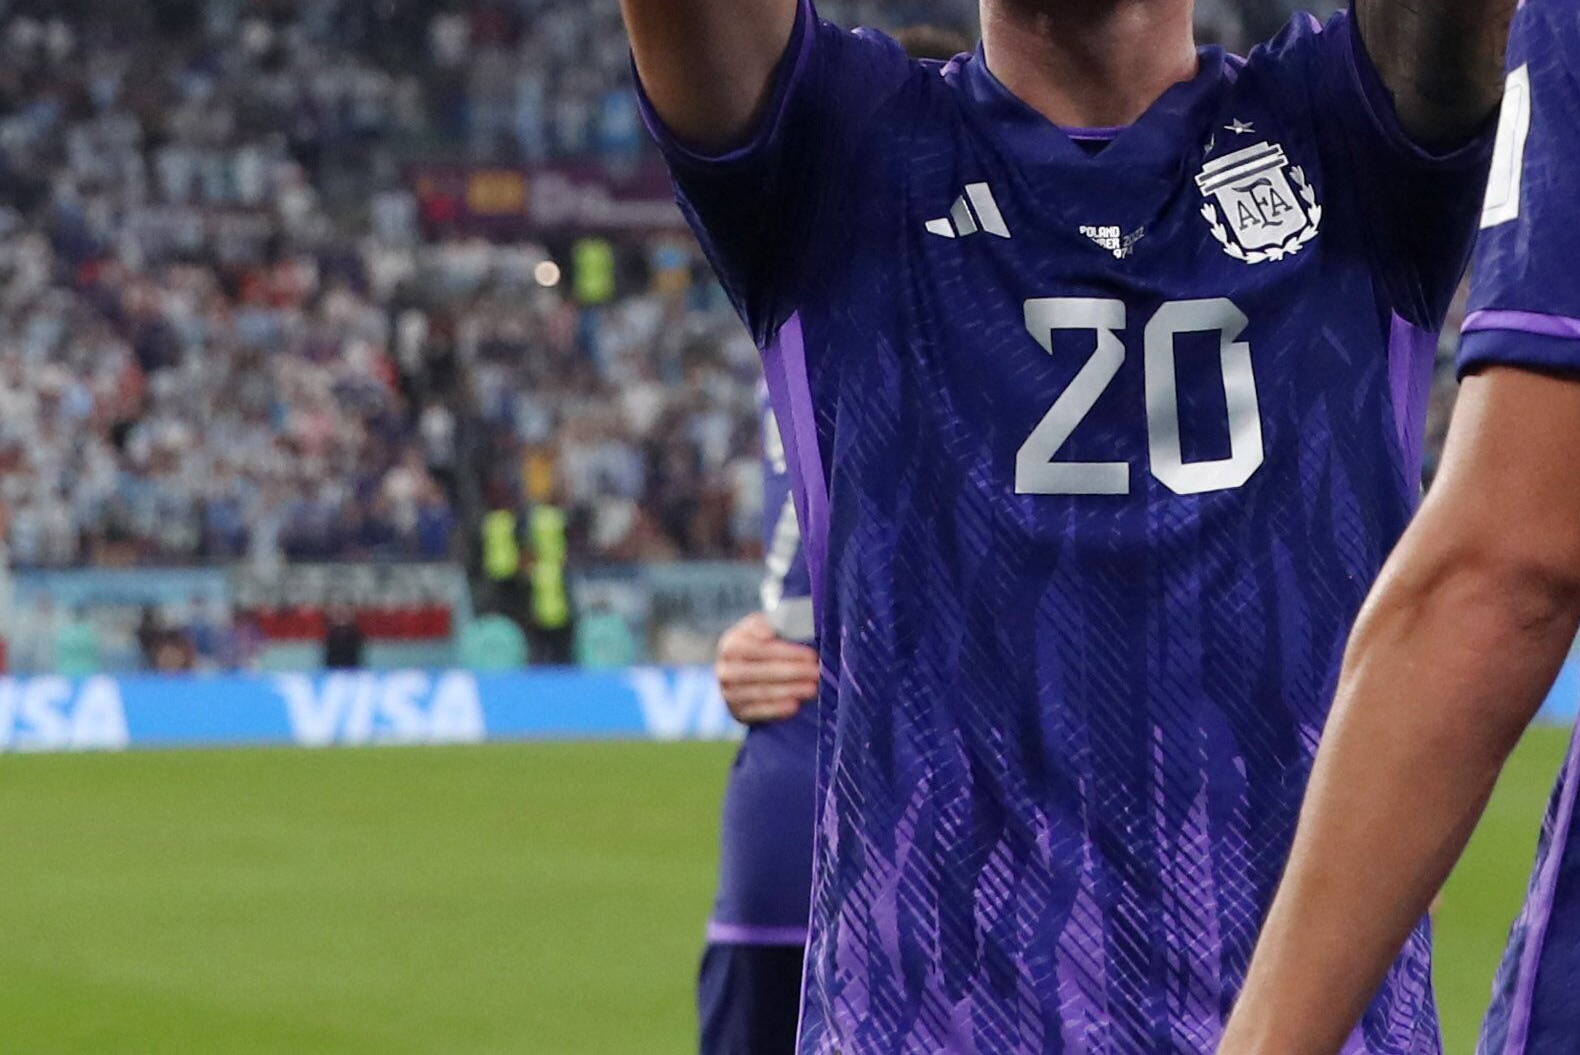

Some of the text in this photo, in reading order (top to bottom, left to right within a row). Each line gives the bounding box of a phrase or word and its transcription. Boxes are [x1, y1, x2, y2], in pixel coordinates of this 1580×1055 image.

[1079, 226, 1120, 238] POLAND
[1231, 177, 1294, 231] AFA
[1015, 297, 1264, 495] 20
[0, 667, 746, 751] ISA VISA VI
